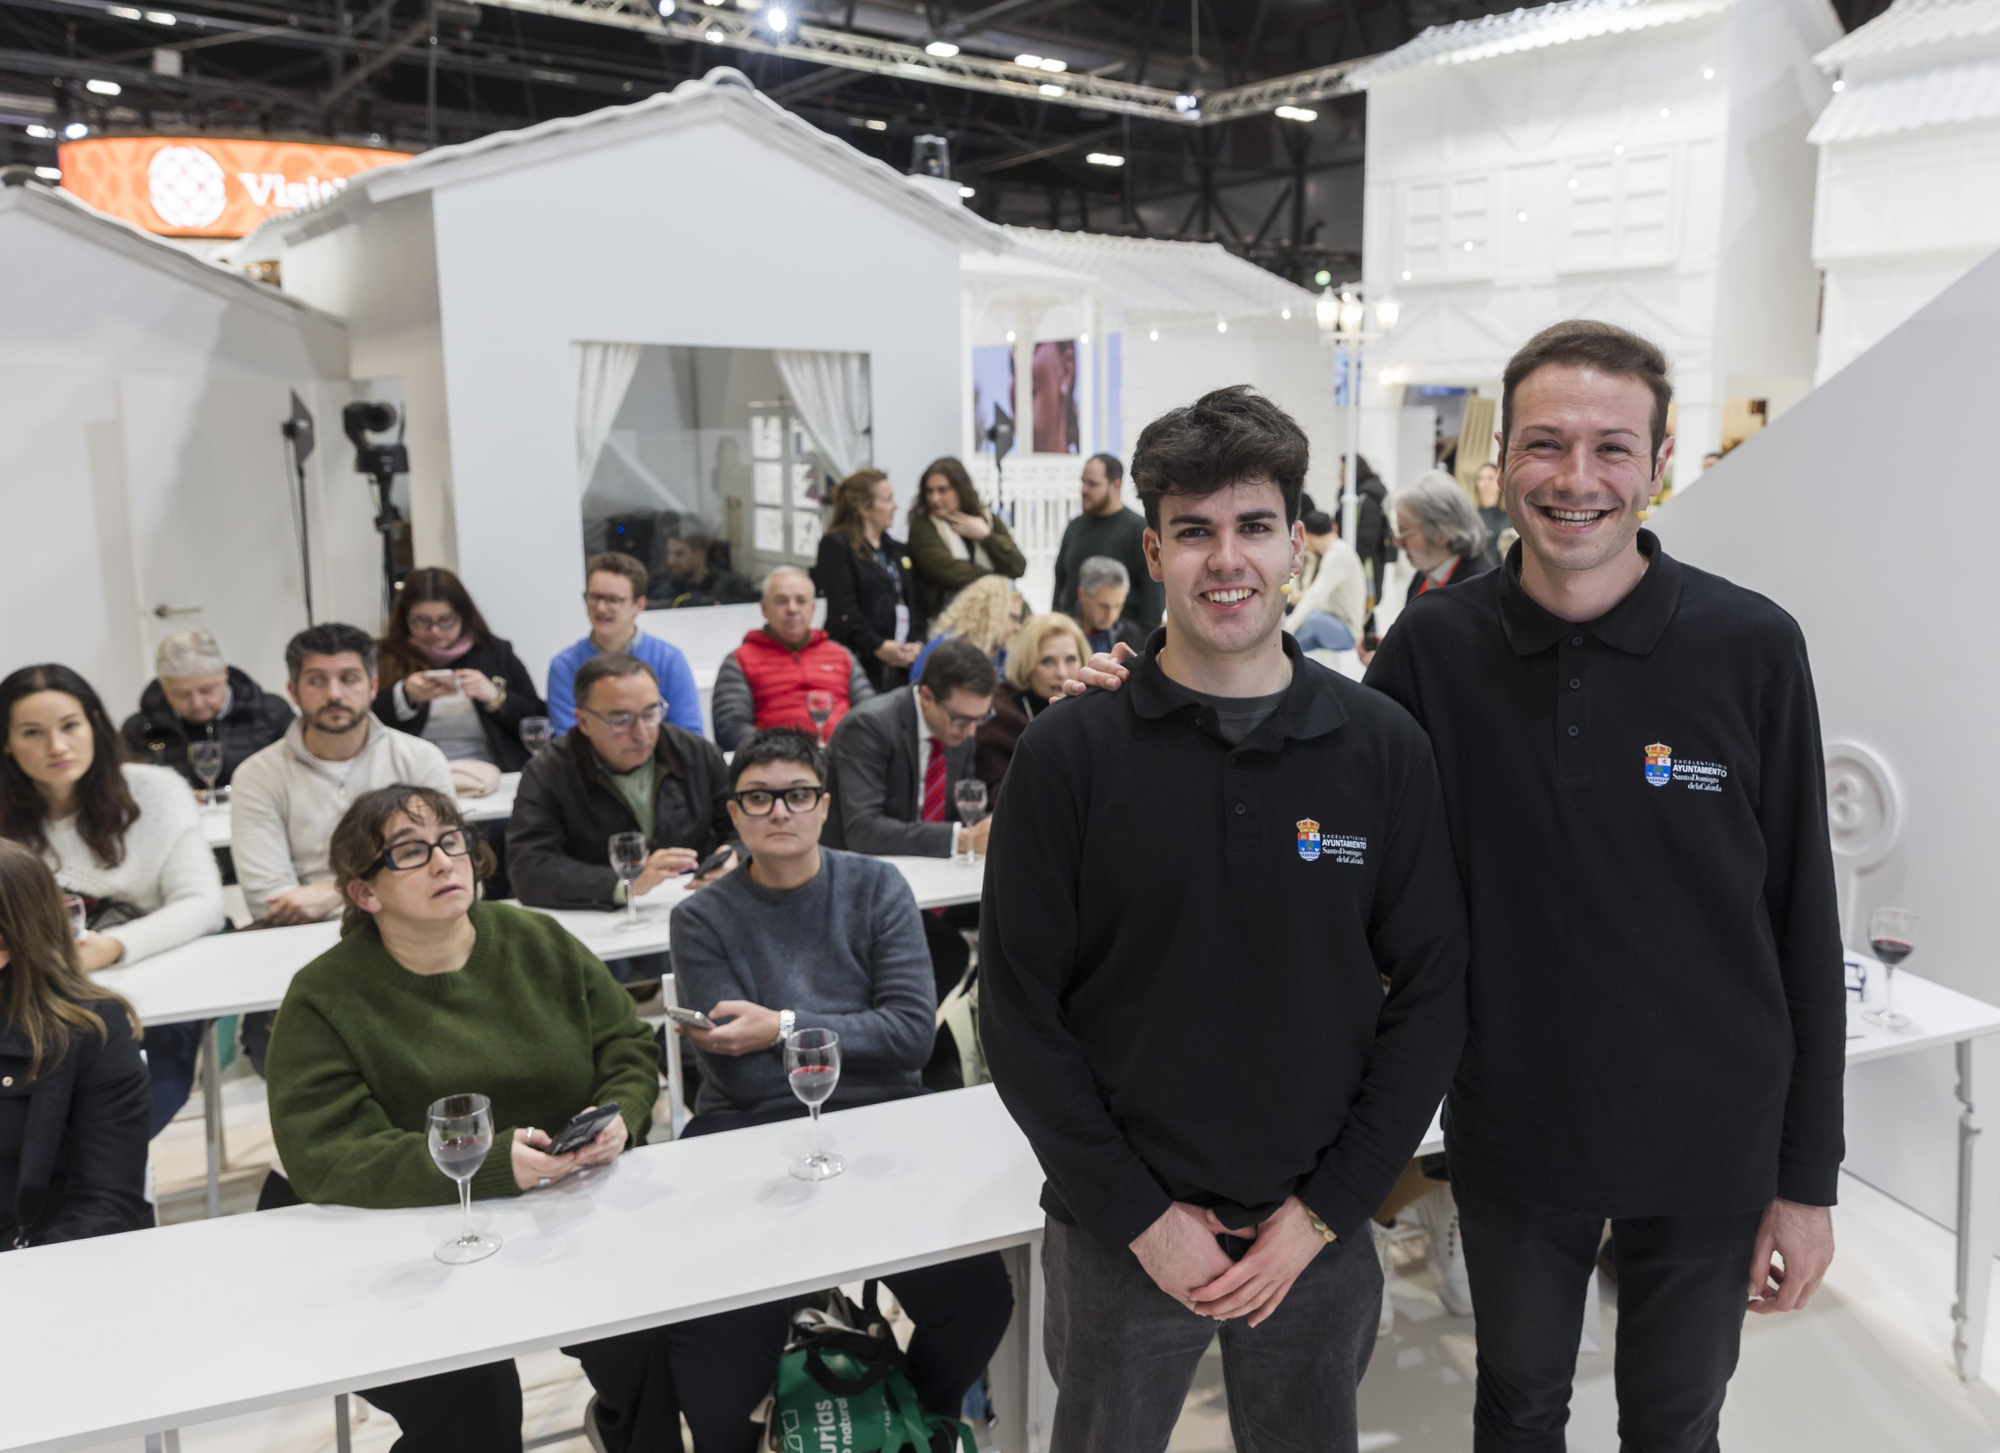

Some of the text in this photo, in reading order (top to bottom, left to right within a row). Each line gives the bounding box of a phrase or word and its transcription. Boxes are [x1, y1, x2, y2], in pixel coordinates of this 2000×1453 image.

[1672, 764, 1727, 778] AYUNTAMIENTO
[1321, 839, 1367, 850] AYUNTAMIENTO
[835, 1398, 853, 1445] natural
